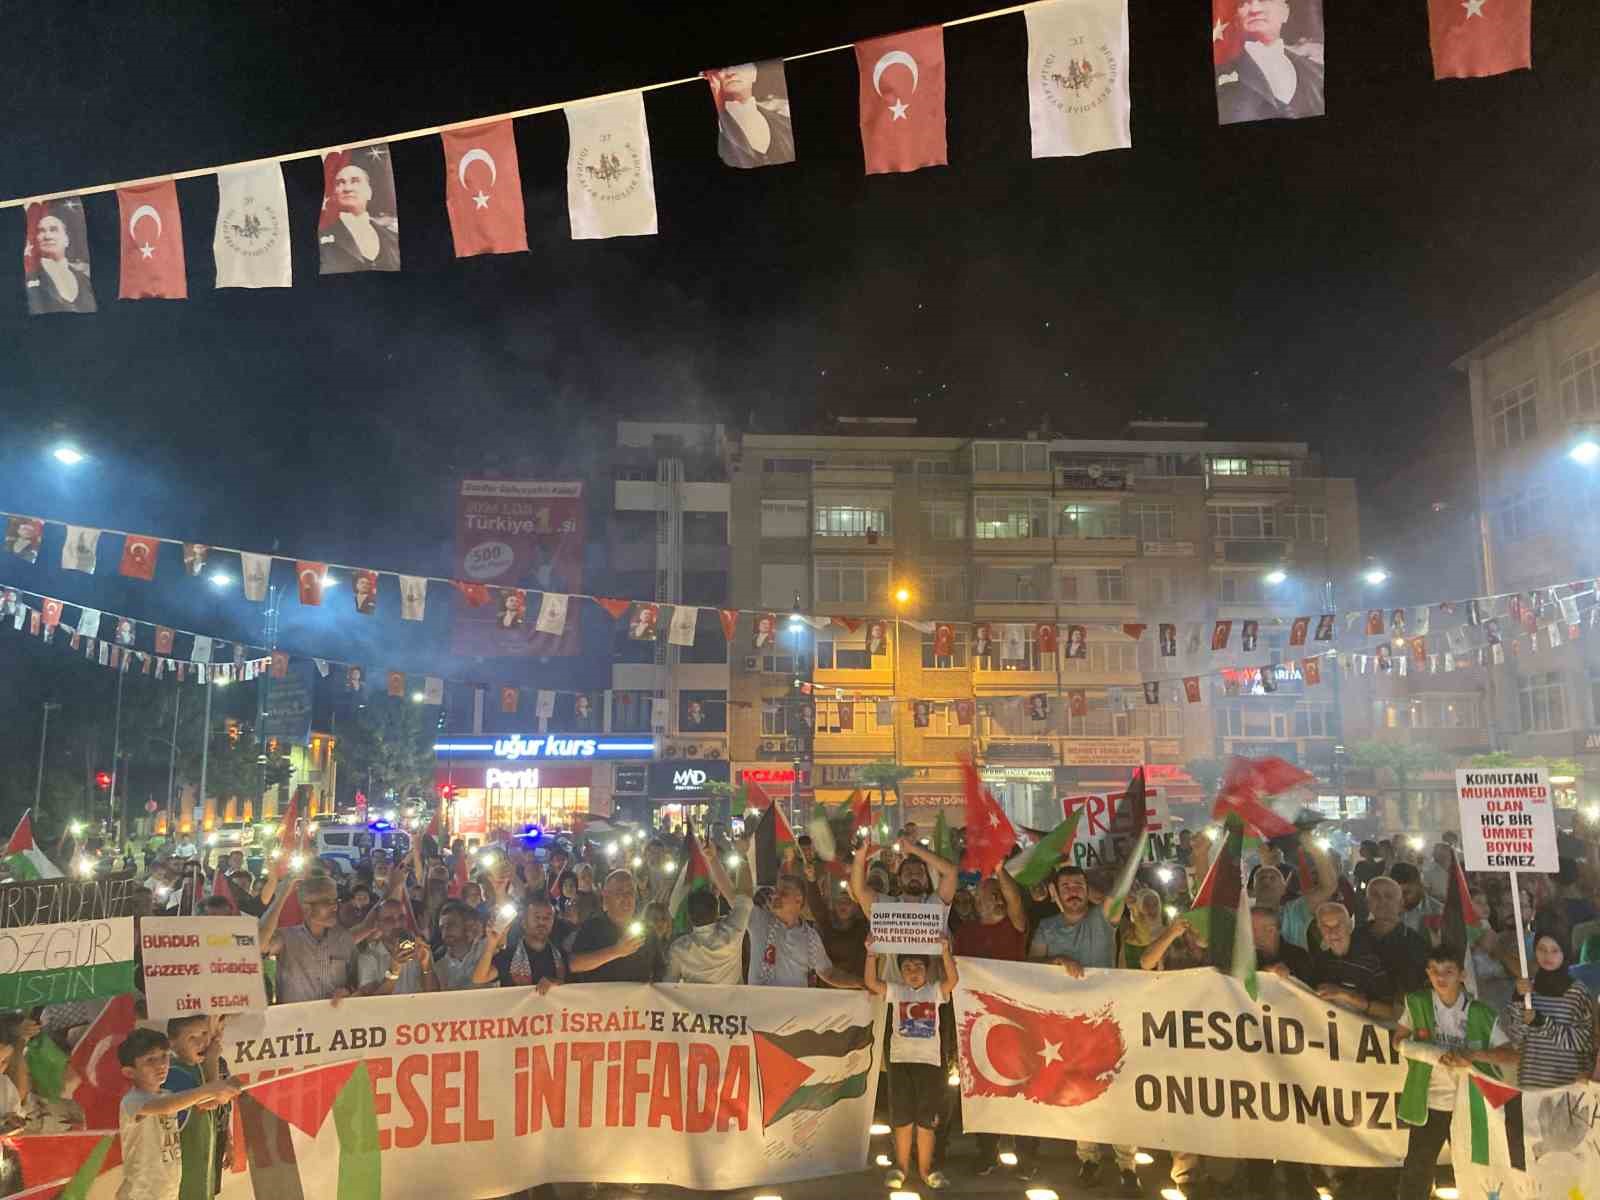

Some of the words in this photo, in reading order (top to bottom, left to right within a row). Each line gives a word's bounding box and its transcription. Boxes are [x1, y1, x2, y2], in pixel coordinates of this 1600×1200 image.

[494, 734, 545, 759] uğur
[545, 734, 596, 756] kurs
[1465, 772, 1540, 785] KOMUTANI
[1460, 786, 1547, 799] MUHAMMED
[1486, 800, 1523, 812] OLAN
[1508, 812, 1533, 826] BİR
[1482, 825, 1534, 839] ÜMMET
[1486, 841, 1534, 853] BOYUN
[1487, 853, 1536, 867] EĞMEZ
[873, 912, 890, 920] OUR
[891, 912, 931, 920] FREEDOM
[873, 927, 888, 935] THE
[889, 927, 928, 936] FREEDOM
[144, 963, 201, 977] GAZZEYE
[234, 1027, 321, 1063] KATİL
[328, 1025, 388, 1052] ABD
[395, 1013, 554, 1046] SOYKIRIMCI
[560, 1006, 664, 1033] İSRAİL'E
[672, 1010, 748, 1039] KARŞI
[1141, 1004, 1341, 1062] MESCİD-İ
[514, 1039, 751, 1137] İNTİFADA
